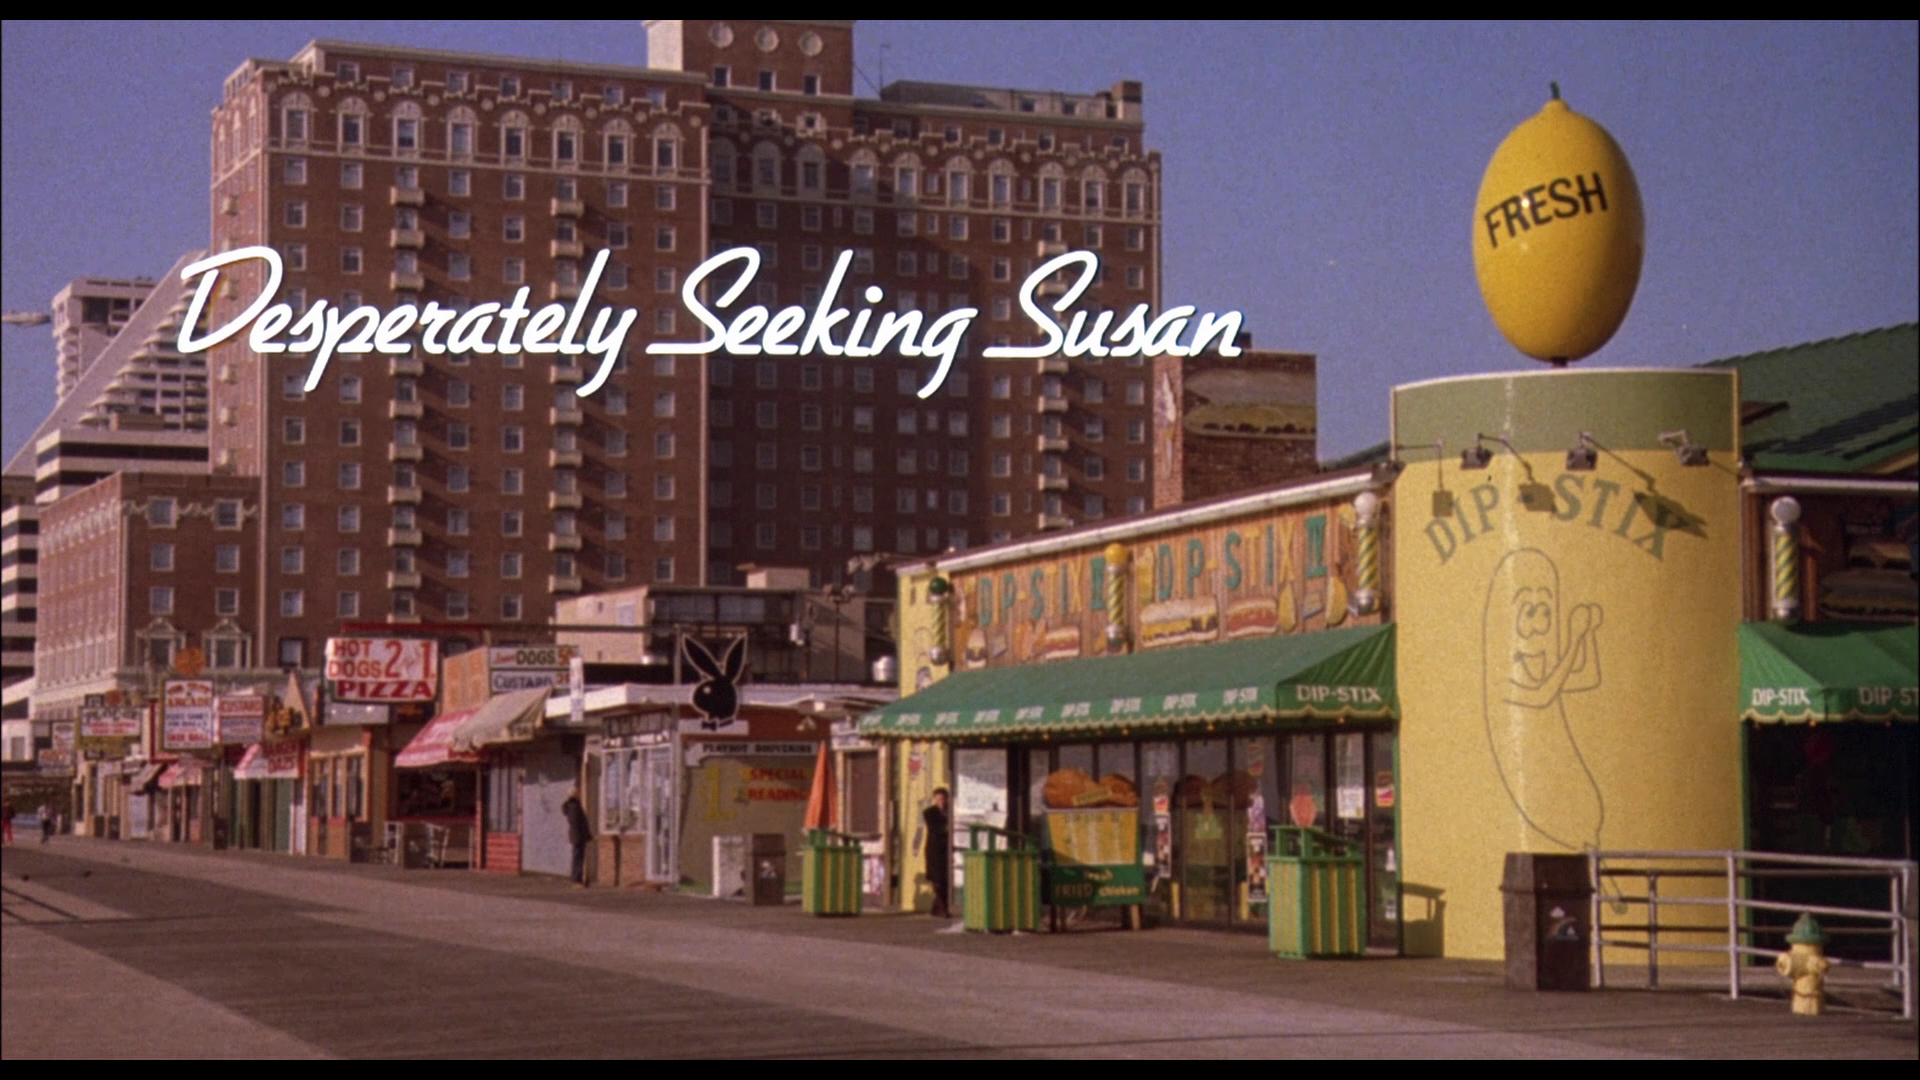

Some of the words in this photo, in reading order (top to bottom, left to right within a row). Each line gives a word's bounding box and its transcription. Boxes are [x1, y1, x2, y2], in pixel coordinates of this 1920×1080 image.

[1484, 172, 1608, 248] FRESH
[333, 639, 373, 656] HOT
[384, 640, 403, 679] 2
[516, 649, 556, 666] DOGS
[328, 660, 382, 678] DOGS
[337, 681, 433, 698] PIZZA
[1296, 684, 1382, 703] DIP-STIX
[1751, 687, 1811, 706] DIP-STIX
[750, 767, 805, 780] SPECIAL
